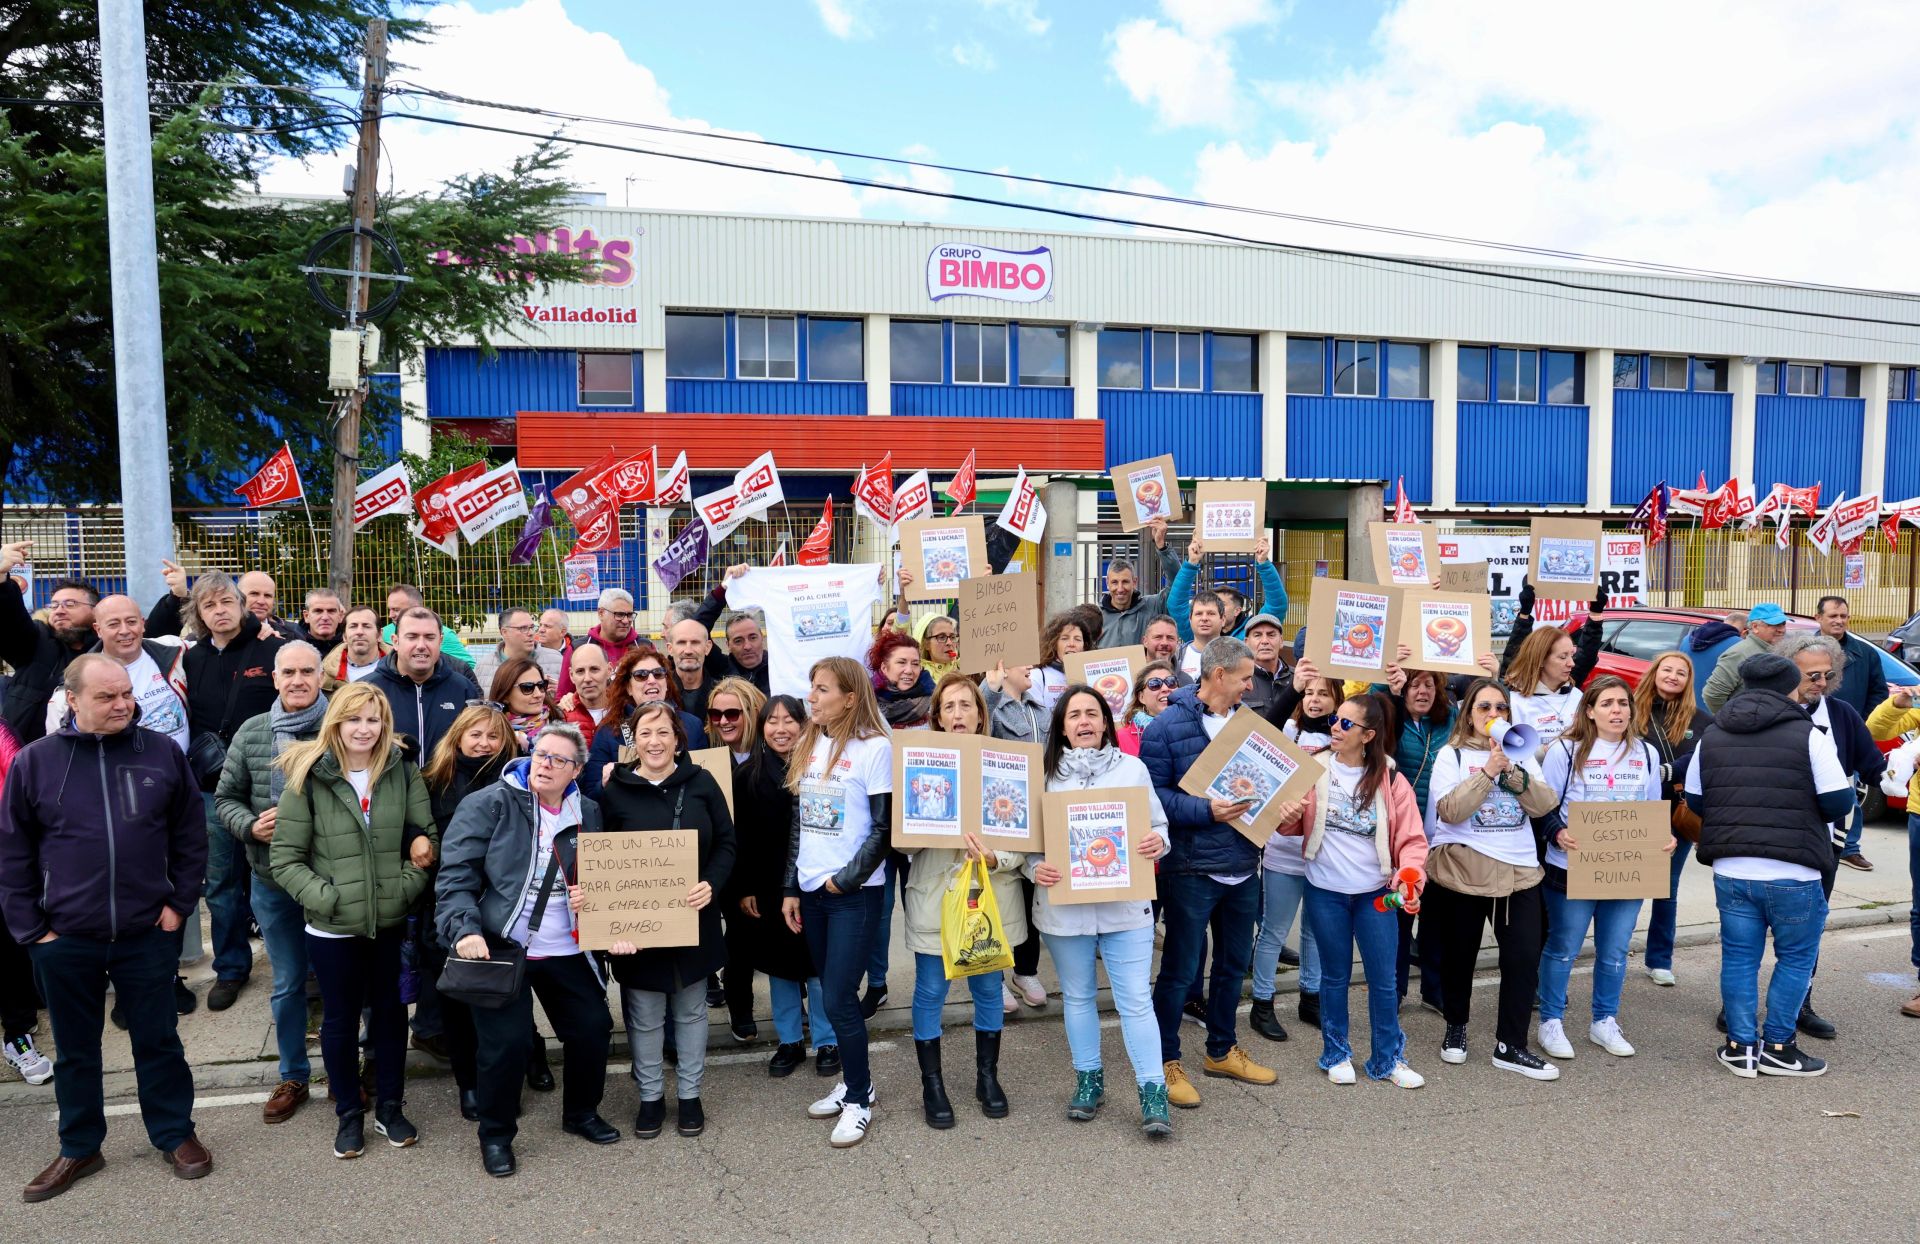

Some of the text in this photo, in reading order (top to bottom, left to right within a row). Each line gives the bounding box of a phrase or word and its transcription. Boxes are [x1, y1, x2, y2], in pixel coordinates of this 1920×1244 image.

[940, 247, 981, 259] GRUPO
[940, 259, 1046, 290] BIMBO
[523, 305, 637, 323] Valladolid
[1608, 543, 1630, 555] UGT
[1486, 557, 1509, 566] POR
[1624, 557, 1640, 565] FICA
[1446, 571, 1458, 585] NO
[976, 581, 1012, 600] BIMBO
[963, 602, 1017, 622] SE LLEVA
[1356, 602, 1386, 611] LUCHA!!!
[971, 622, 1018, 639] NUESTRO
[984, 642, 1005, 657] PAN
[144, 684, 171, 699] CIERRE
[927, 760, 957, 768] LUCHA!!!
[998, 761, 1026, 771] LUCHA!!!
[1263, 750, 1292, 776] LUCHA!!!
[1069, 803, 1124, 813] BIMBO VALLADOLID
[1090, 812, 1124, 820] LUCHA!!!
[1581, 809, 1638, 824] VUESTRA
[1592, 828, 1648, 842] GESTION
[582, 836, 686, 852] POR UN PLAN
[584, 857, 675, 871] INDUSTRIAL
[1579, 851, 1643, 863] NUESTRA
[1594, 870, 1641, 883] RUINA
[580, 877, 686, 893] PARA GARANTIZAR
[582, 898, 687, 912] EL EMPLEO EN
[610, 919, 663, 935] BIMBO
